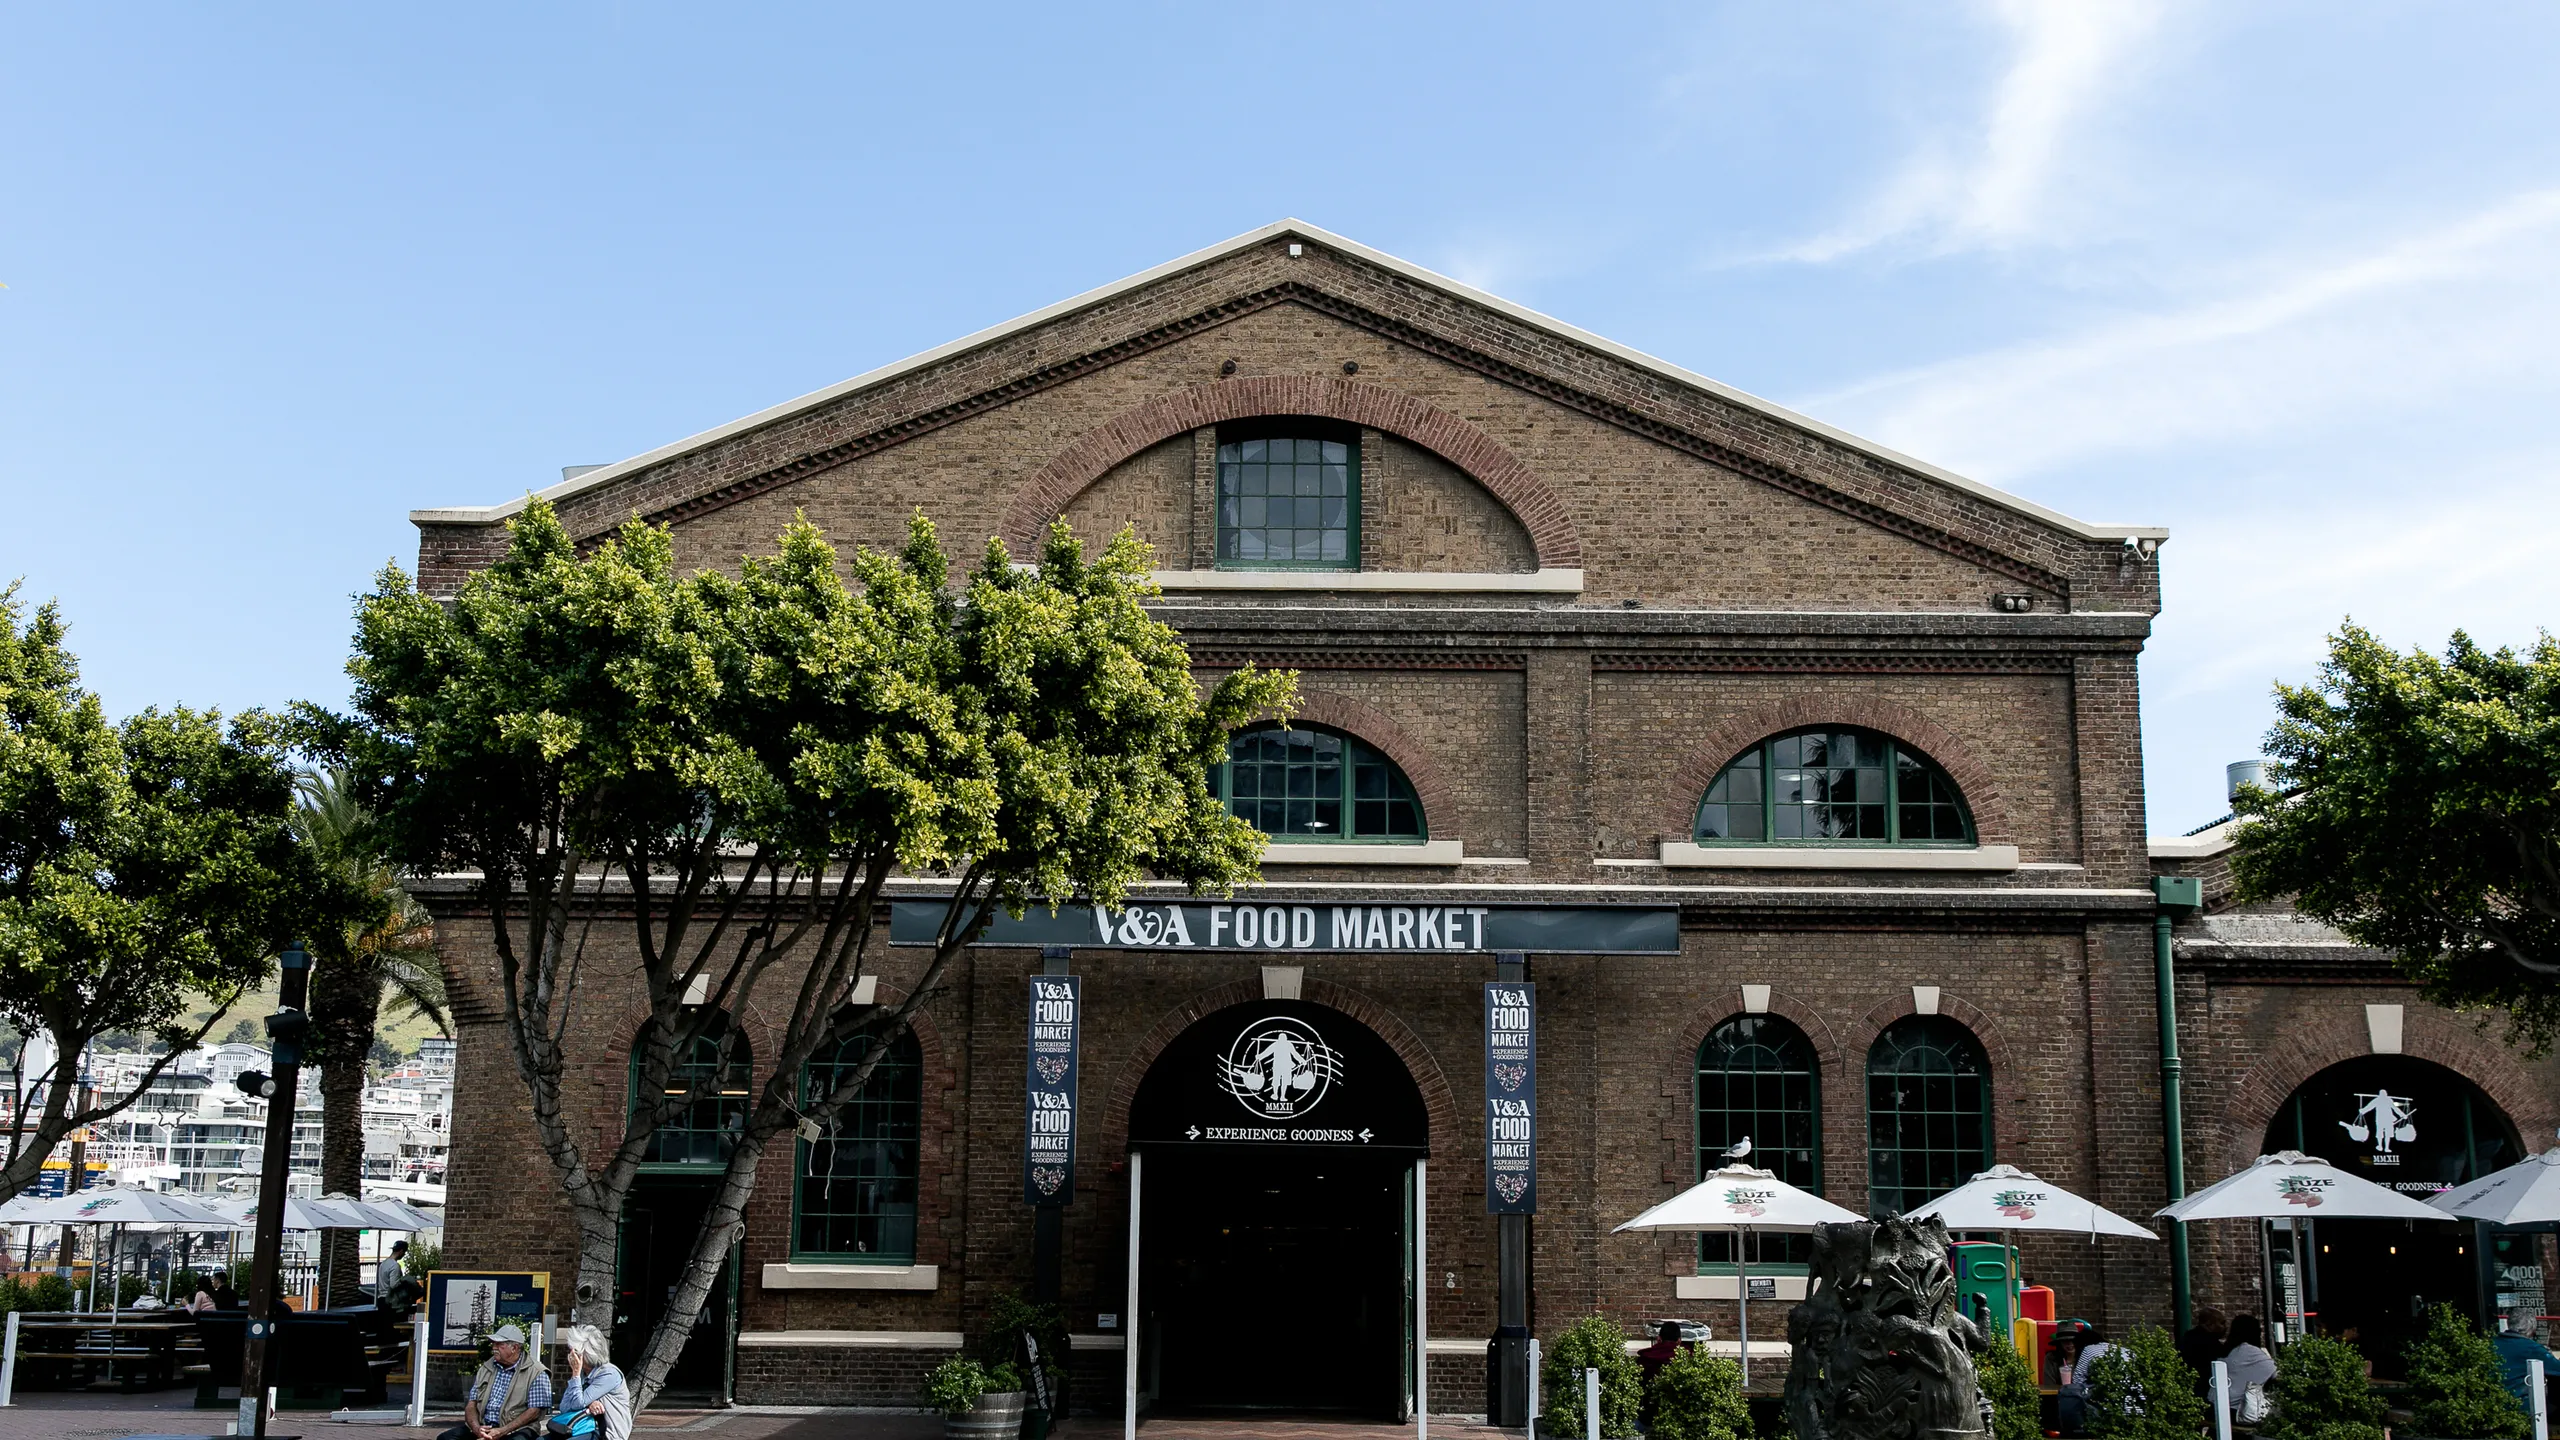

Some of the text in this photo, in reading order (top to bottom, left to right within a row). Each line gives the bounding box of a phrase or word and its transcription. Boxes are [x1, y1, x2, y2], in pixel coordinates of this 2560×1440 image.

[1096, 905, 1488, 950] V&A FOOD MARKET
[1034, 982, 1074, 999] V&A
[1489, 989, 1530, 1006] V&A
[1035, 1001, 1073, 1022] FOOD
[1491, 1007, 1529, 1030] FOOD
[1034, 1026, 1072, 1040] MARKET
[1491, 1033, 1529, 1047] MARKET
[1031, 1091, 1071, 1109] V&A
[1265, 1102, 1293, 1111] MMXII
[1490, 1099, 1531, 1116] V&A
[1031, 1110, 1070, 1133] FOOD
[1492, 1117, 1530, 1140] FOOD
[1206, 1127, 1354, 1141] EXPERIENCE GOODNESS
[1031, 1136, 1069, 1150] MARKET
[1492, 1144, 1530, 1158] MARKET
[2373, 1155, 2400, 1163] MMXII
[2395, 1182, 2443, 1191] GOODNESS
